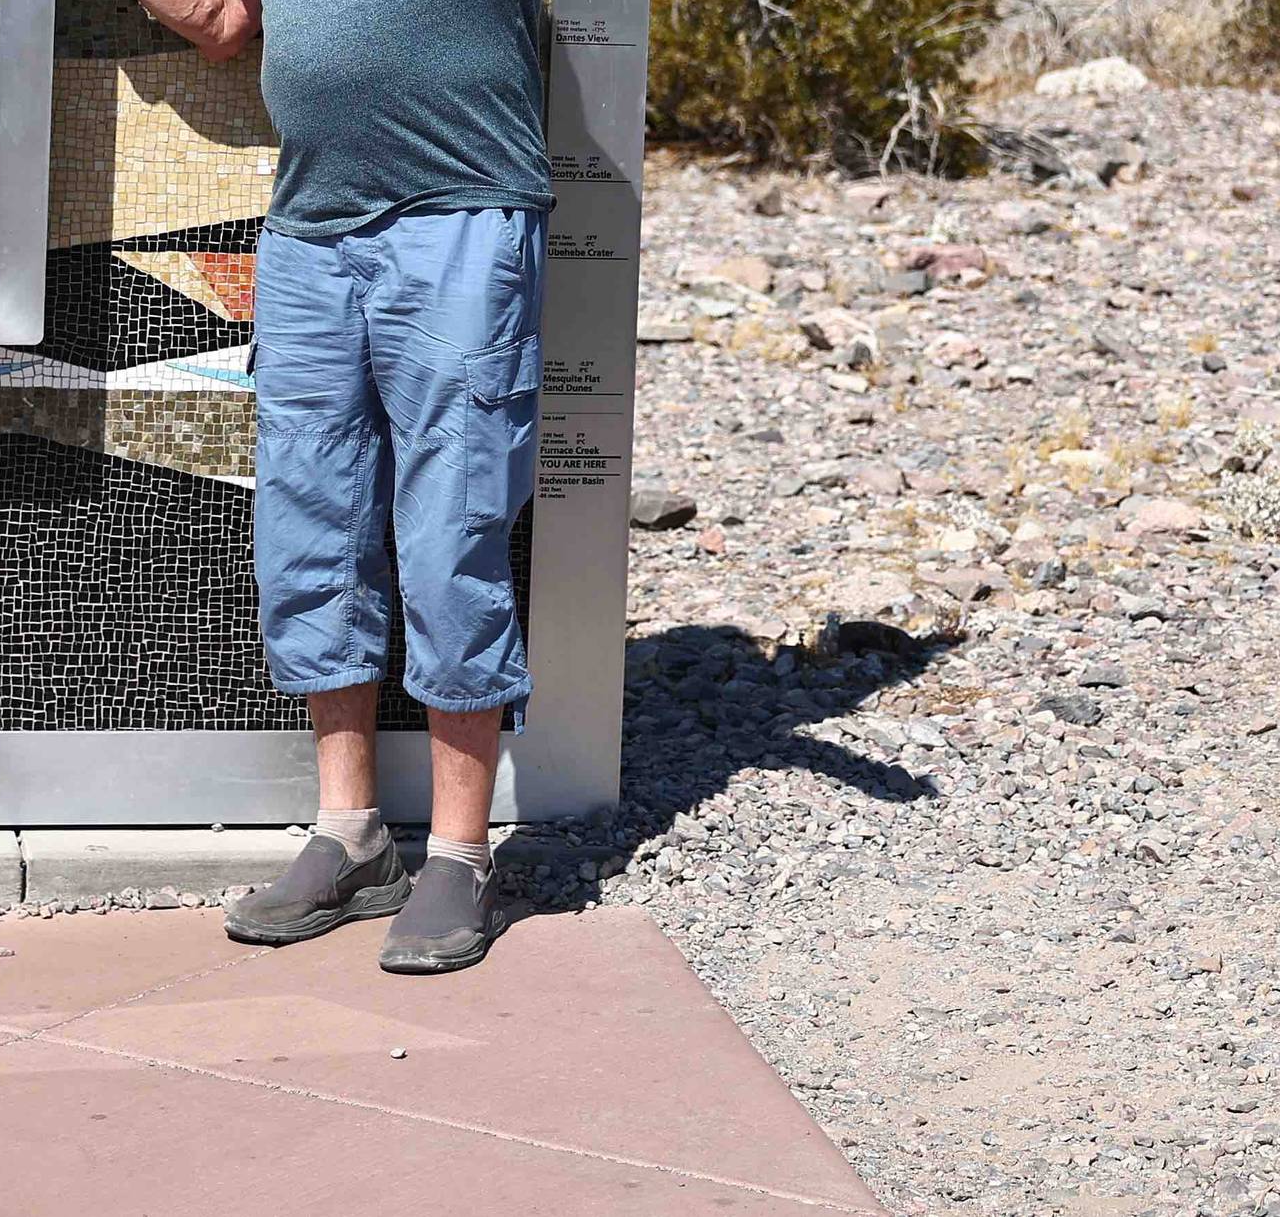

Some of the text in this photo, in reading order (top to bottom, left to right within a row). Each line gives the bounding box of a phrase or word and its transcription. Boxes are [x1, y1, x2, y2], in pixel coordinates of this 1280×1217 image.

[555, 33, 609, 42] Dantes View
[586, 170, 612, 179] Castle
[547, 248, 615, 258] Ubehebe Crater
[543, 374, 601, 384] Mesquite Flat
[542, 383, 593, 392] Sand Dunes
[540, 446, 600, 455] Furnace Creek
[540, 460, 607, 469] YOU ARE HERE
[538, 476, 605, 485] Badwater Basin
